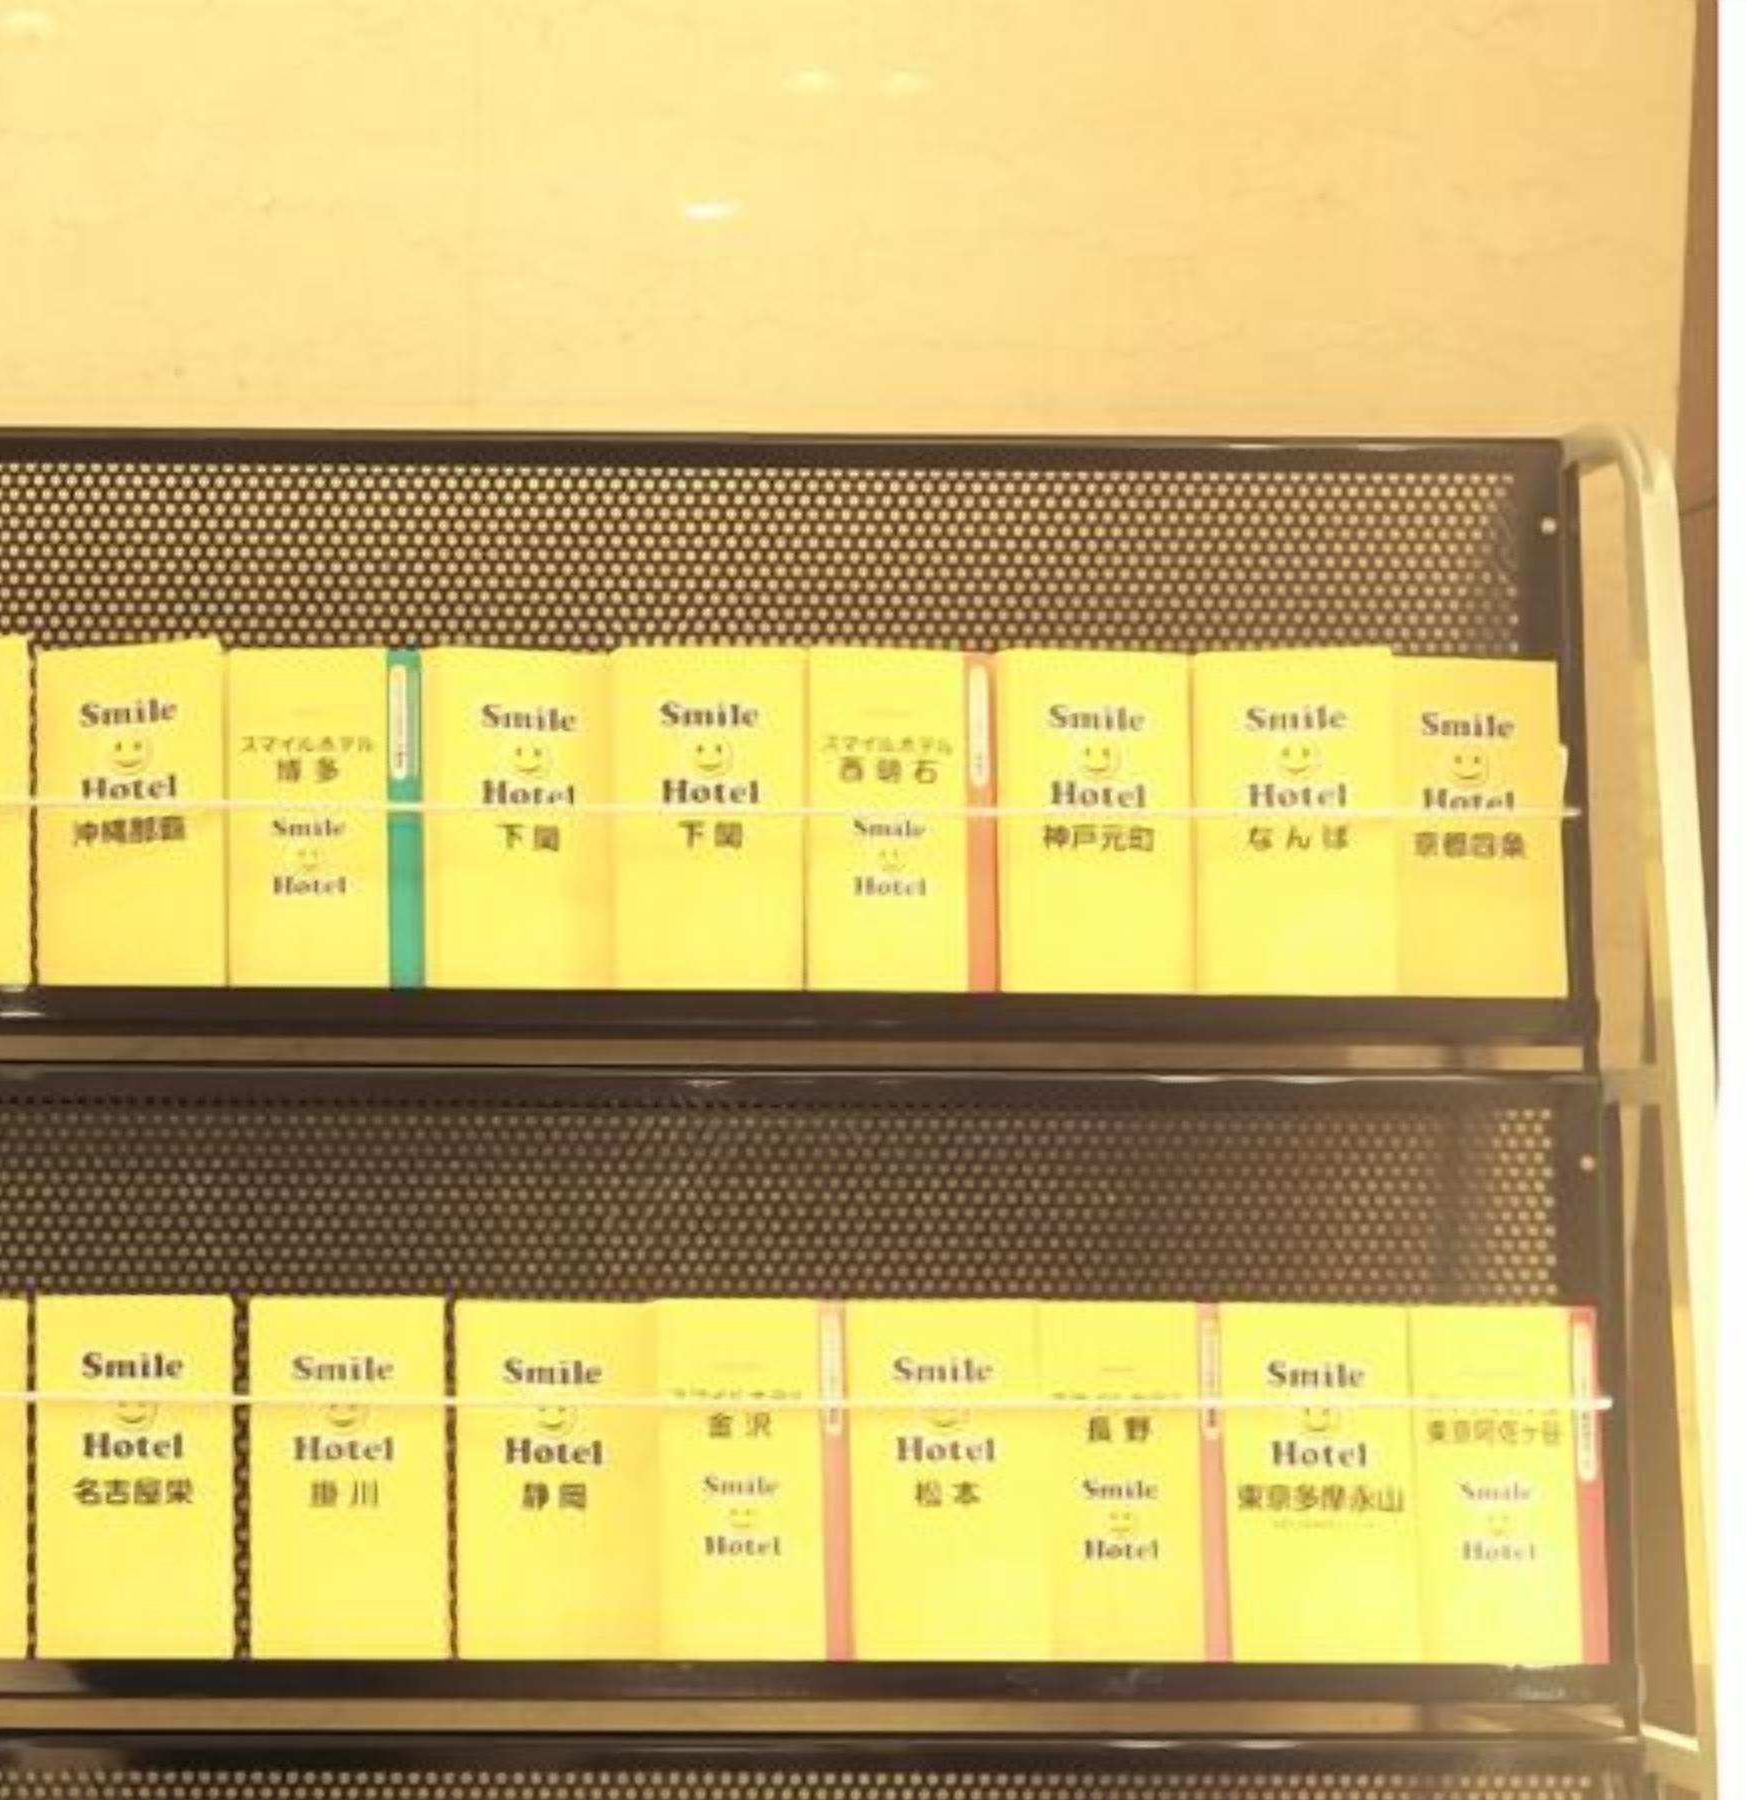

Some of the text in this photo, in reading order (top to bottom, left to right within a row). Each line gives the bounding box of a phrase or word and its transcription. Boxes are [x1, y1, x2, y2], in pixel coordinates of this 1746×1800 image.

[81, 698, 179, 729] Smile
[482, 704, 578, 733] Smile
[660, 702, 760, 729] Smile
[1049, 705, 1146, 733] Smile
[1246, 706, 1348, 733] Smile
[1422, 713, 1516, 740] Smile
[277, 757, 341, 785] 博多
[82, 773, 178, 801] Hotel
[483, 779, 576, 806] Hotel
[663, 779, 760, 806] Hotel
[1051, 780, 1147, 808] Hotel
[1249, 783, 1348, 808] Hotel
[272, 819, 347, 838] Smile
[498, 823, 562, 854] 下関
[679, 820, 745, 851] 下関
[854, 819, 927, 839] Smile
[1043, 824, 1156, 854] 神戸元町
[1248, 825, 1350, 853] なんば
[273, 876, 348, 897] Hotel
[854, 876, 928, 898] Hotel
[83, 1352, 185, 1380] Smile
[292, 1356, 395, 1383] Smile
[504, 1358, 604, 1387] Smile
[893, 1357, 995, 1384] Smile
[1268, 1361, 1366, 1389] Smile
[708, 1412, 773, 1441] 金沢
[83, 1432, 184, 1461] Hotel
[294, 1436, 395, 1464] Hotel
[506, 1437, 604, 1467] Hotel
[897, 1437, 996, 1464] Hotel
[1272, 1441, 1368, 1469] Hotel
[74, 1478, 195, 1508] 名古屋栄
[523, 1482, 588, 1512] 静岡
[703, 1476, 780, 1497] Smile
[915, 1481, 982, 1509] 松本
[1083, 1480, 1159, 1501] Smile
[1456, 1481, 1532, 1502] Smile
[705, 1536, 782, 1558] Hotel
[1085, 1540, 1160, 1561] Hotel
[1462, 1540, 1537, 1562] Hotel
